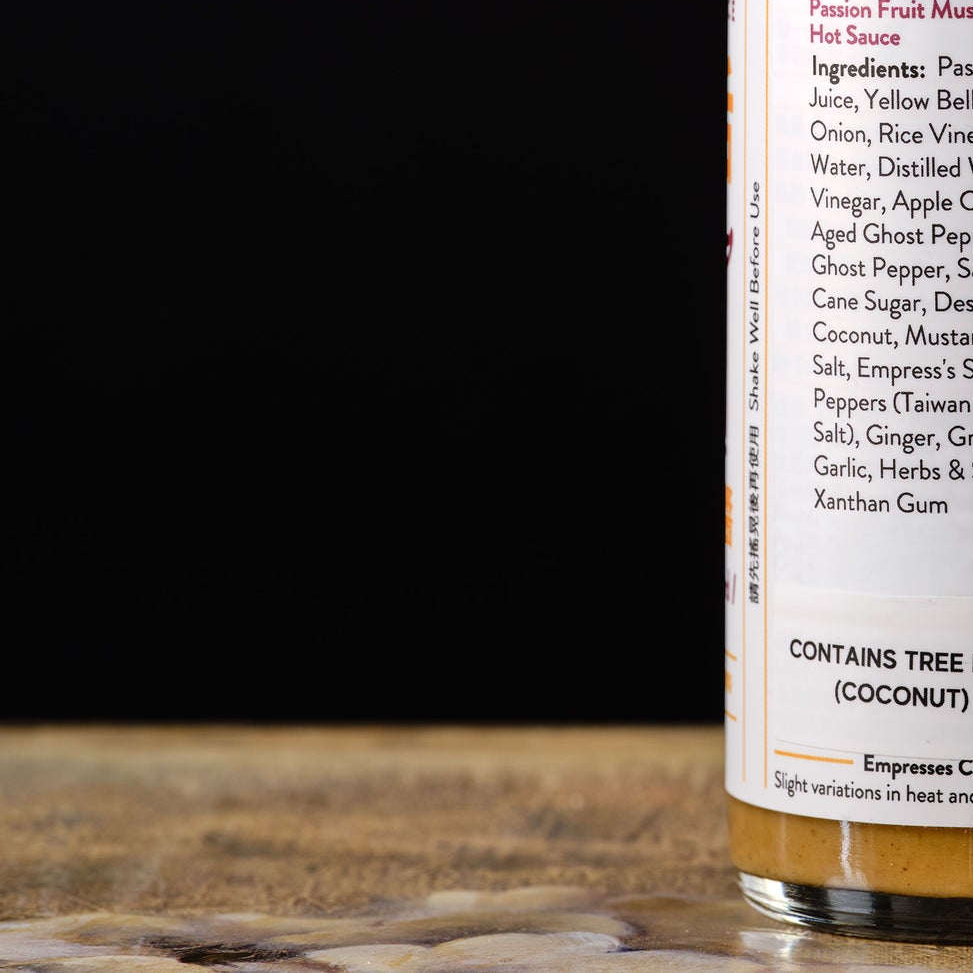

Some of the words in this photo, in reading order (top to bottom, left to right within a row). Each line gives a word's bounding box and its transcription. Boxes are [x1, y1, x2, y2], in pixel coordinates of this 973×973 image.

[878, 0, 925, 19] Fruit
[810, 24, 842, 44] Hot
[846, 25, 901, 45] Sauce
[812, 55, 925, 85] Ingredients:
[809, 87, 859, 113] Juice,
[864, 89, 929, 110] Yellow
[810, 120, 872, 147] Onion,
[879, 123, 923, 144] Rice
[810, 153, 871, 180] Water,
[878, 156, 961, 178] Distilled
[750, 181, 760, 218] Use
[810, 187, 886, 218] Vinegar,
[892, 190, 953, 219] Apple
[810, 221, 856, 250] Aged
[863, 223, 924, 244] Ghost
[749, 227, 760, 294] Before
[812, 254, 866, 277] Ghost
[873, 257, 951, 286] Pepper,
[812, 287, 858, 310] Cane
[864, 290, 927, 319] Sugar,
[749, 300, 760, 344] Well
[812, 321, 899, 348] Coconut,
[749, 352, 760, 412] Shake
[813, 354, 851, 381] Salt,
[857, 357, 955, 386] Empress's
[814, 388, 886, 418] Peppers
[893, 391, 971, 414] (Taiwan
[813, 421, 860, 448] Salt),
[866, 424, 941, 454] Ginger,
[814, 455, 872, 482] Garlic,
[880, 458, 940, 480] Herbs
[949, 459, 965, 480] &
[814, 488, 889, 512] Xanthan
[897, 492, 948, 514] Gum
[790, 639, 897, 669] CONTAINS
[905, 651, 963, 672] TREE
[835, 680, 969, 713] (COCONUT)
[864, 754, 953, 779] Empresses
[774, 770, 808, 797] Slight
[811, 780, 881, 800] variations
[887, 785, 900, 801] in
[906, 785, 943, 803] heat
